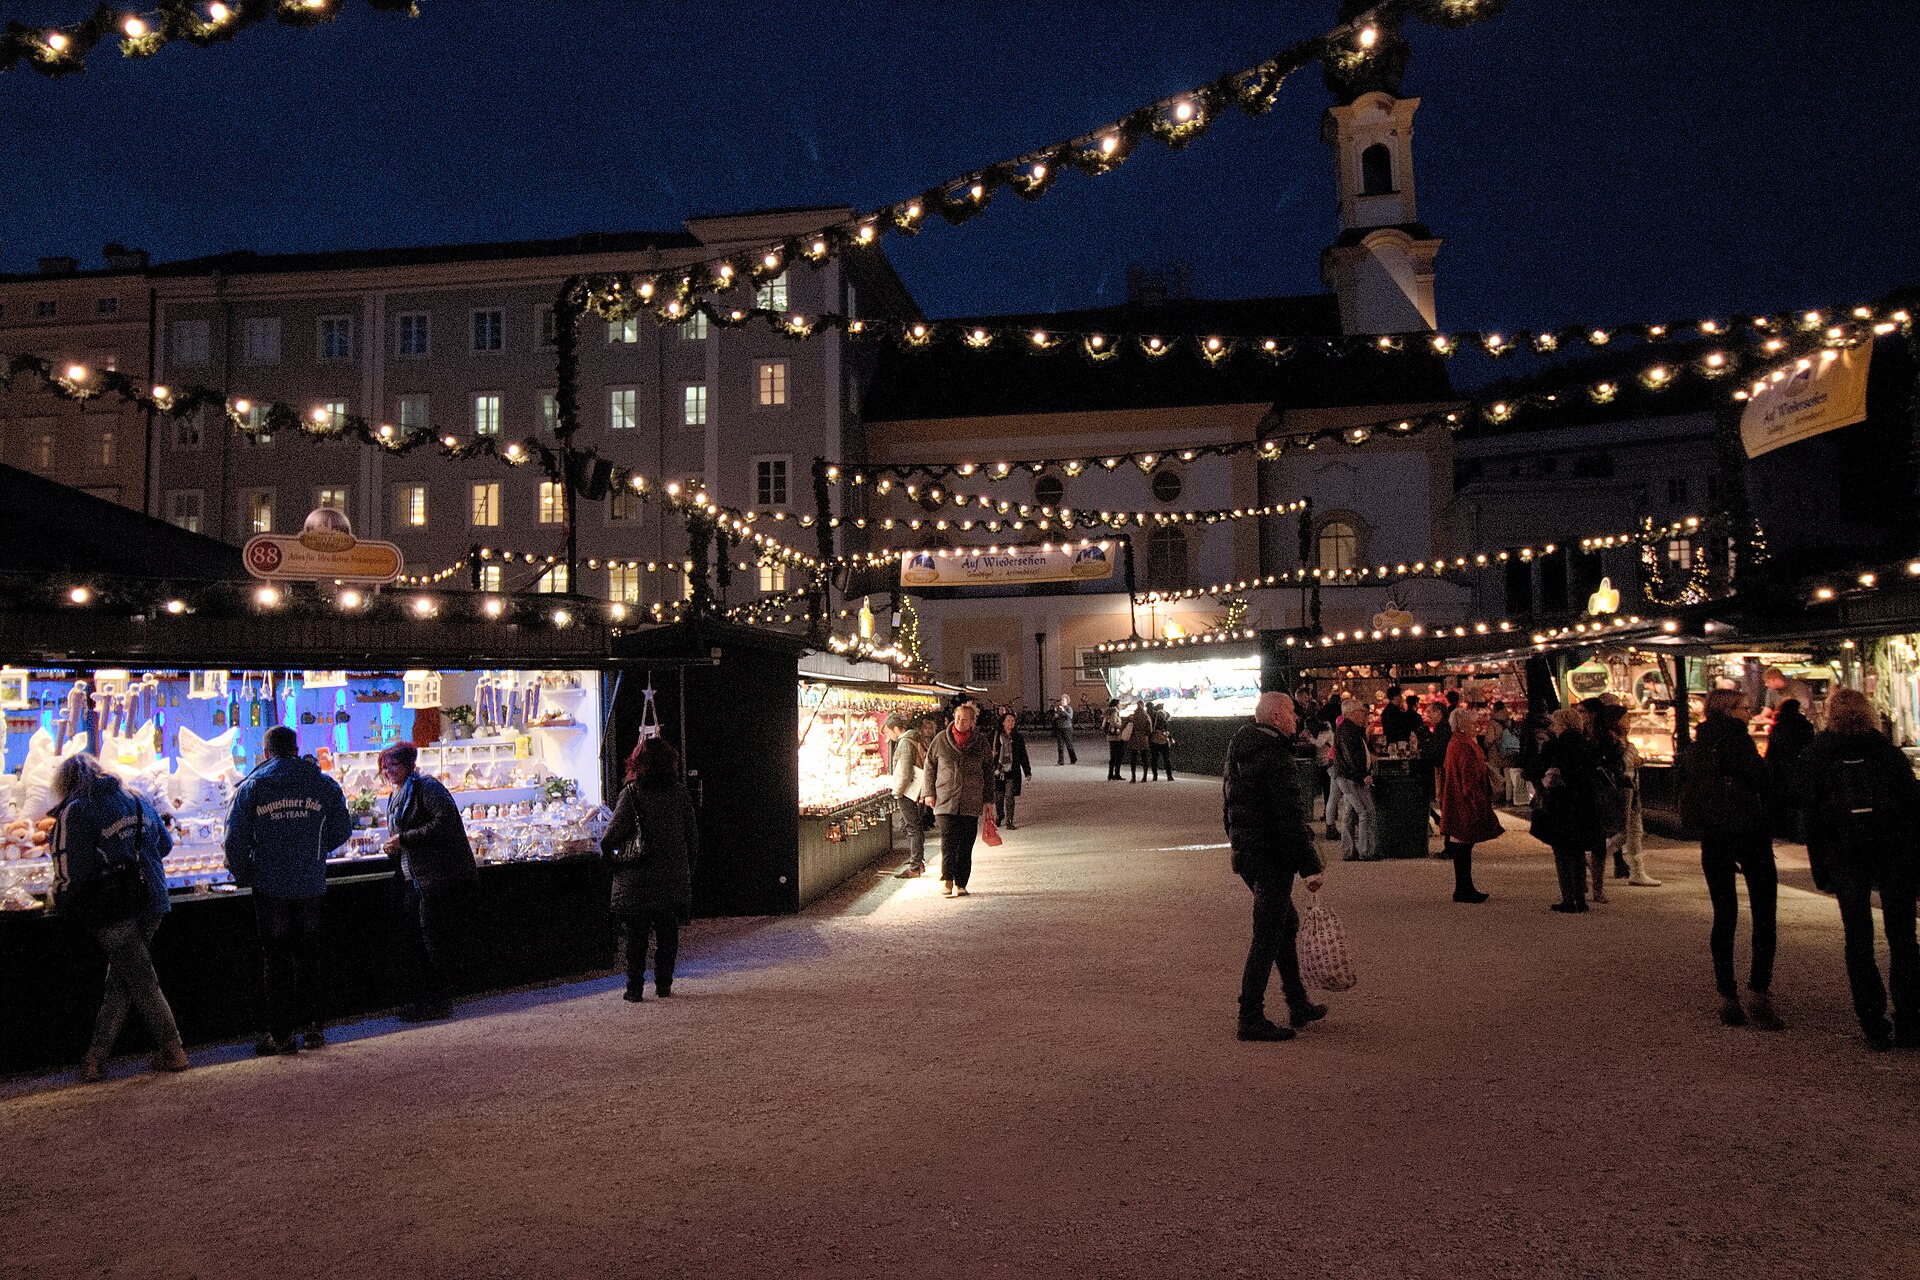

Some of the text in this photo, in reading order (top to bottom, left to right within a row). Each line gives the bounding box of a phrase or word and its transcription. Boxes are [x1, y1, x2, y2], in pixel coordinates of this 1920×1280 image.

[253, 546, 278, 564] 88
[961, 555, 1046, 572] Auf Wiedersehen
[256, 798, 304, 817] Augustiner
[270, 810, 308, 821] SKI-TEAM
